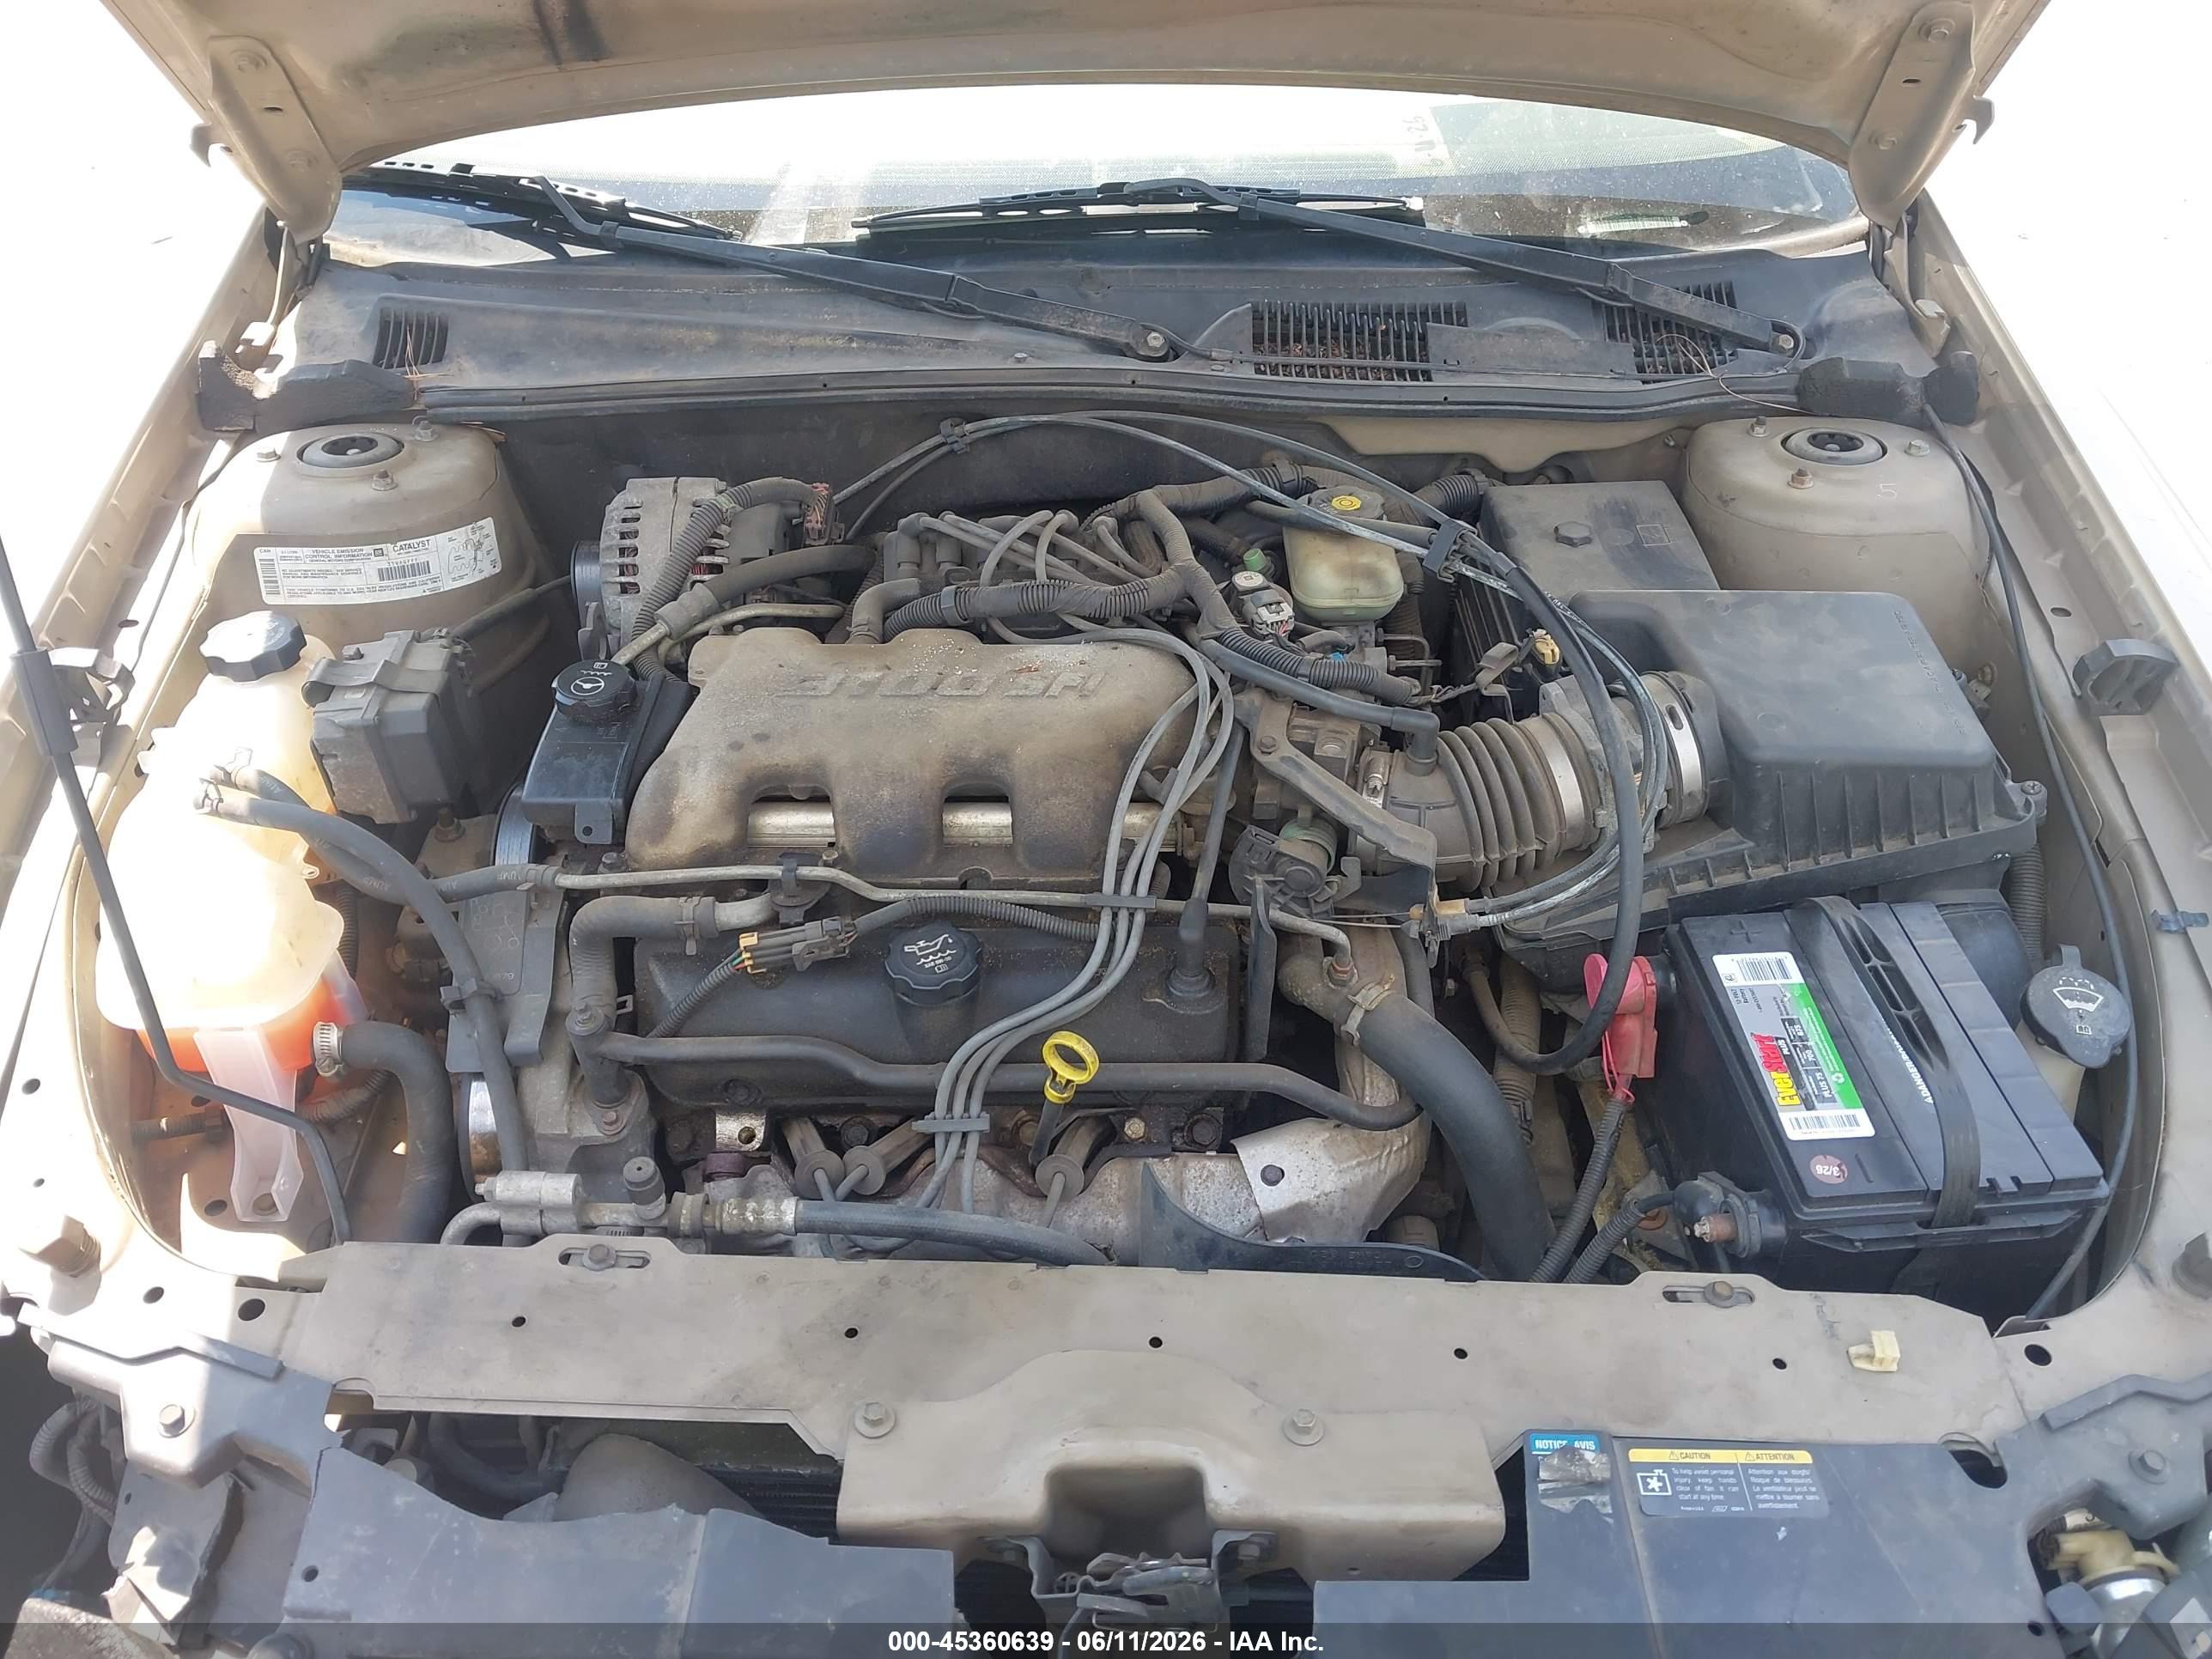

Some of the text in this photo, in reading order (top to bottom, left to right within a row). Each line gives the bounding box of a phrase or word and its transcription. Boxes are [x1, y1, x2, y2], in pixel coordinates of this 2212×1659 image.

[392, 538, 431, 552] CATALYST
[1777, 1038, 1791, 1056] PLUS
[1750, 1032, 1802, 1106] EverStart
[1815, 1164, 1840, 1177] 3/26
[1574, 1440, 1595, 1450] AVIS
